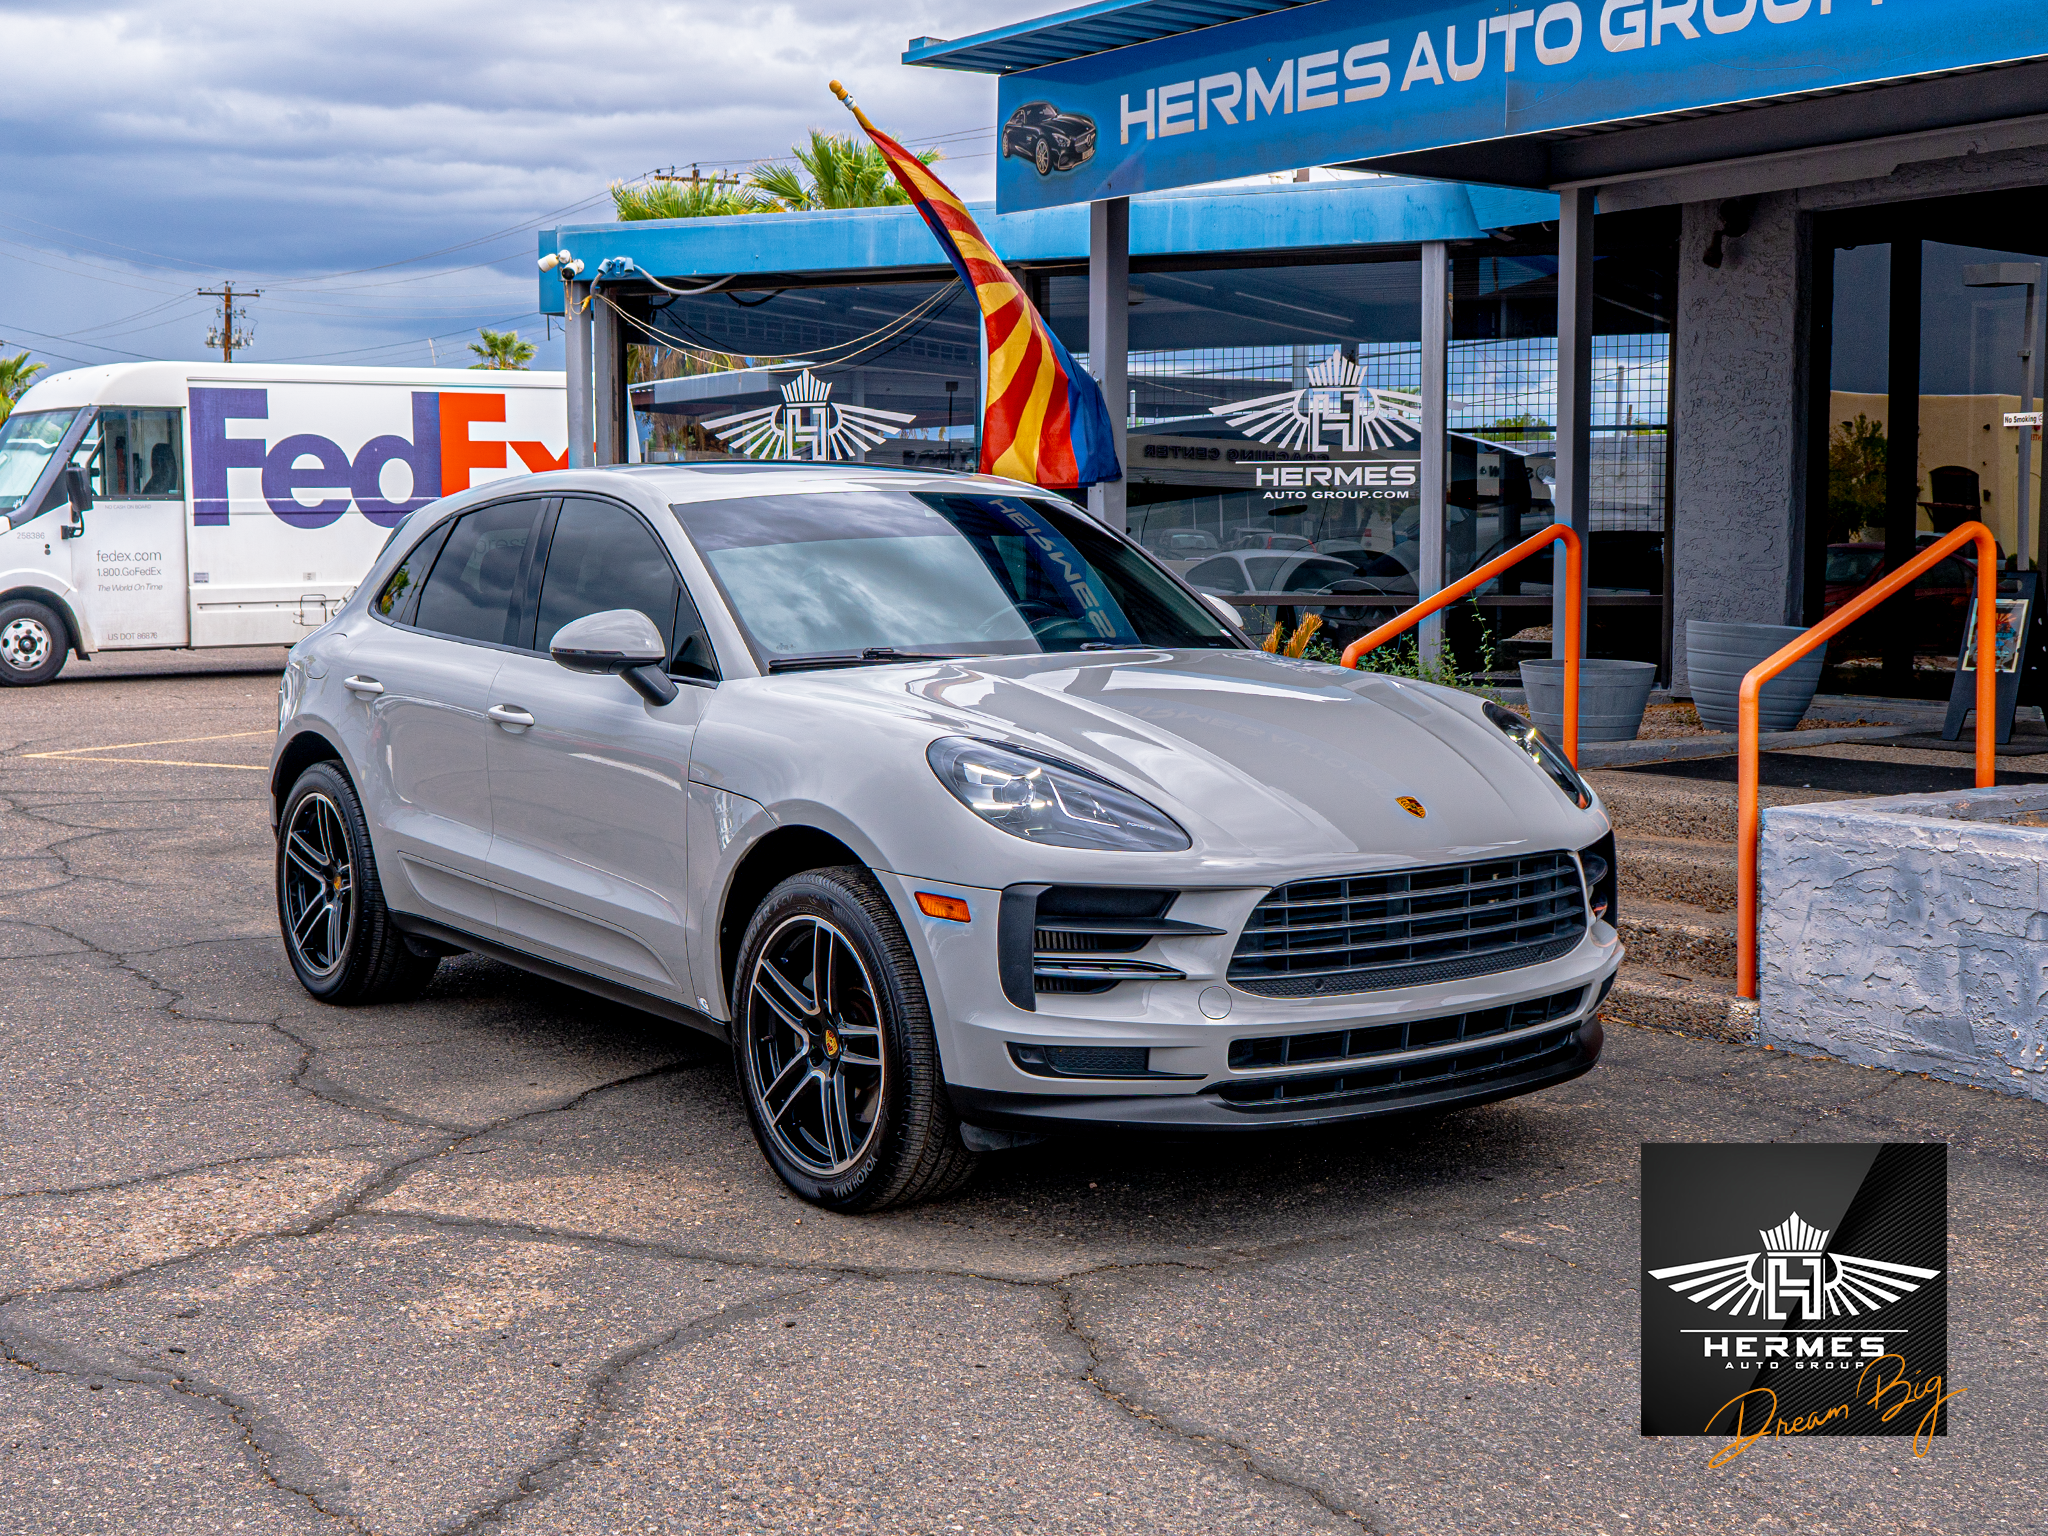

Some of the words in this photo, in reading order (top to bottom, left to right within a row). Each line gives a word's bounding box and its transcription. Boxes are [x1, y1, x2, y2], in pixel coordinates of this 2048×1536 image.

[1120, 38, 1391, 145] HERMES
[1400, 1, 1583, 92] AUTO
[1599, 0, 1833, 53] GRO
[2004, 416, 2012, 424] No
[2013, 415, 2037, 425] Smoking
[1256, 466, 1416, 487] HERMES
[1263, 491, 1307, 500] AUTO
[1312, 490, 1409, 499] GROUP.COM
[17, 532, 46, 540] 258386
[97, 550, 162, 563] fedex.com
[97, 566, 162, 577] 1.800.GoFedEx
[98, 584, 111, 592] The
[111, 583, 133, 592] World
[133, 583, 145, 591] On
[145, 582, 163, 591] Time
[107, 632, 119, 641] US
[119, 632, 136, 641] DOT
[832, 1154, 878, 1198] YOKOHAMA
